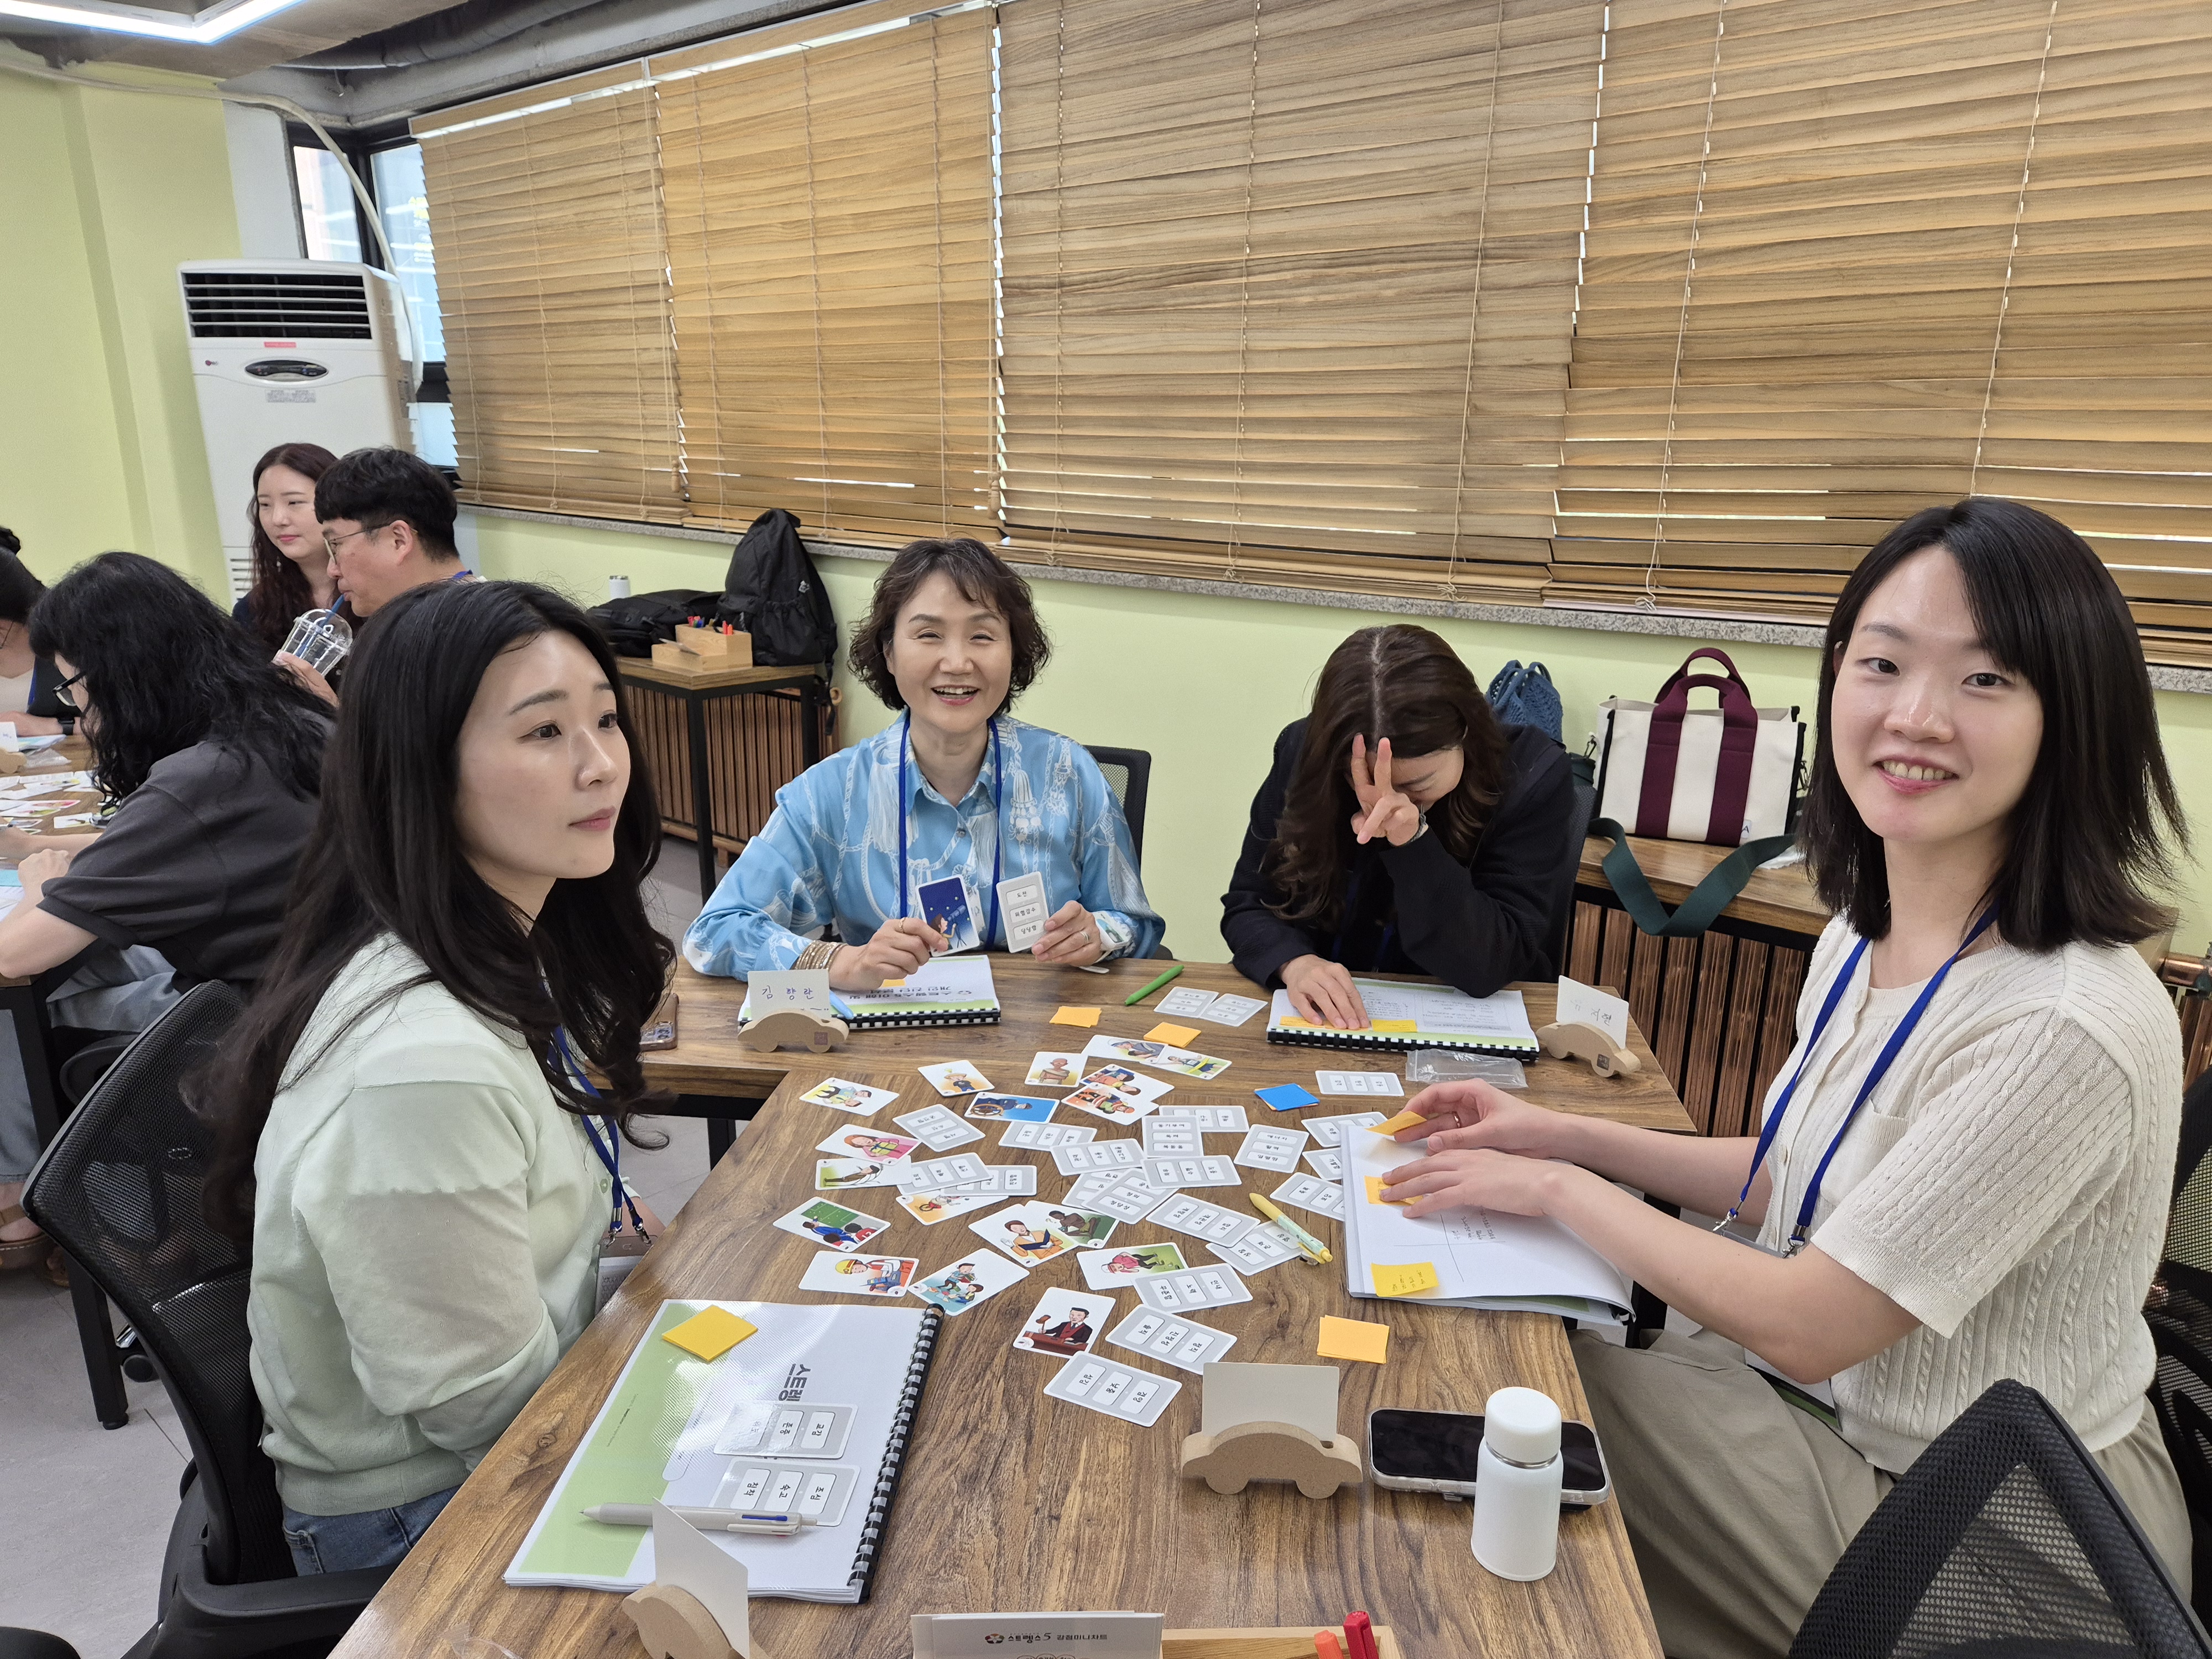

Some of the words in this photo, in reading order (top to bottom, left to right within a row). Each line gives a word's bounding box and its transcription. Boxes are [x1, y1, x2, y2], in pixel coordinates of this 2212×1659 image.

[1015, 907, 1036, 917] 위험감수
[1020, 925, 1036, 935] 당당함
[761, 985, 773, 1000] 김
[1114, 1146, 1125, 1160] 너그러움
[1173, 1207, 1190, 1218] 개방성
[1194, 1214, 1211, 1225] 객관성
[1219, 1223, 1231, 1231] 합리
[1186, 1284, 1197, 1293] 노력
[1210, 1280, 1223, 1290] 인내
[1160, 1285, 1173, 1300] 꾸준함
[1138, 1324, 1152, 1335] 솔직
[1161, 1331, 1180, 1346] 진정성
[1188, 1343, 1203, 1353] 정직
[778, 1363, 811, 1402] 스트렝
[1079, 1374, 1093, 1385] 섬김
[1105, 1383, 1120, 1394] 낮춤
[1133, 1391, 1147, 1403] 겸양
[780, 1422, 793, 1435] 존중
[811, 1423, 825, 1436] 교감
[743, 1482, 759, 1496] 침착
[779, 1484, 791, 1499] 숙고
[810, 1486, 825, 1500] 조심
